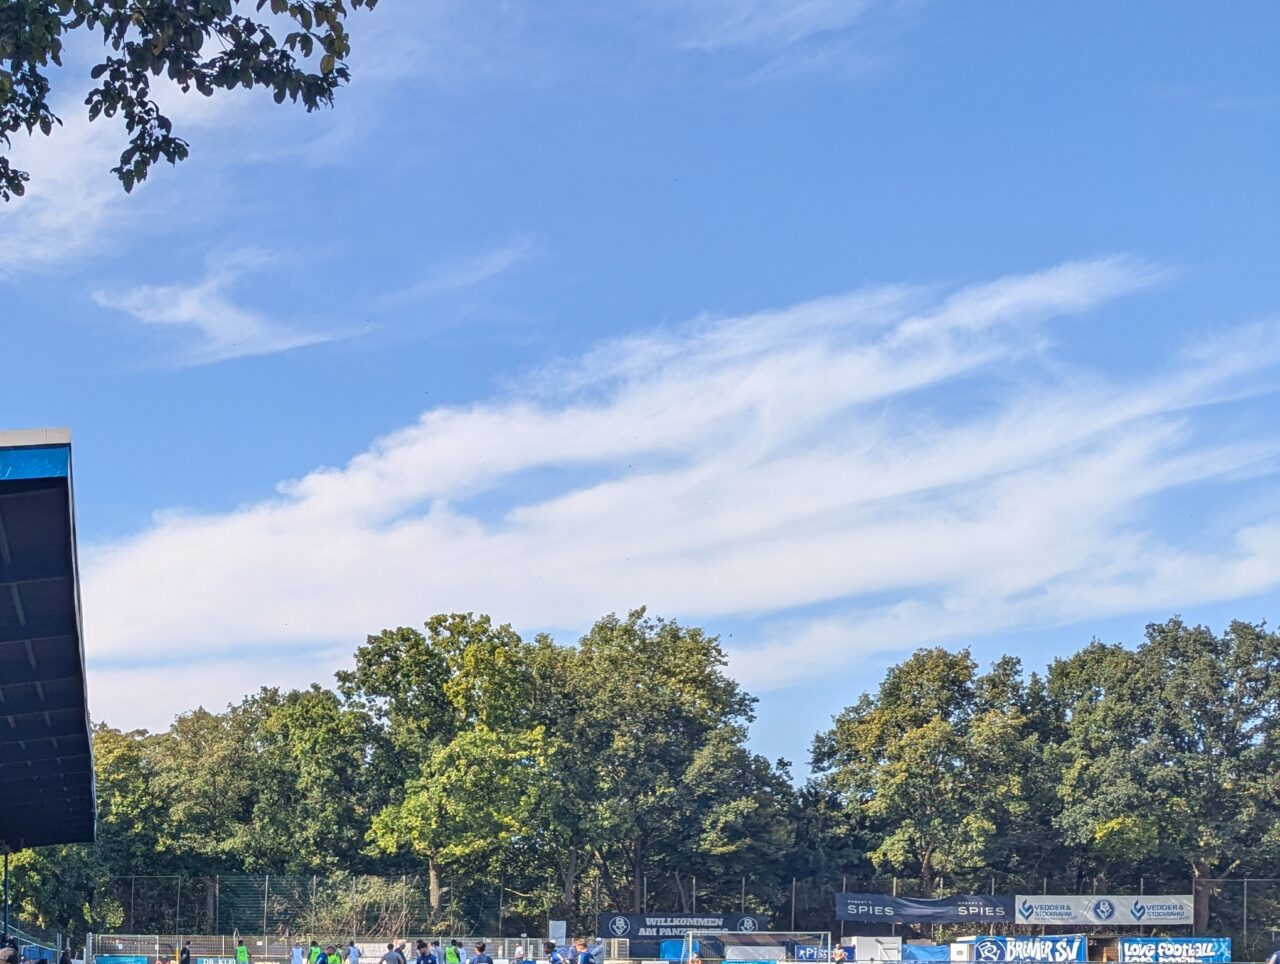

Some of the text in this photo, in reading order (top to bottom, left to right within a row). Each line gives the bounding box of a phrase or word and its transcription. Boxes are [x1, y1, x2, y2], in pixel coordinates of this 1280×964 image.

[847, 905, 895, 916] SPIES
[958, 906, 1005, 916] SPIES
[645, 917, 723, 926] WILLKOMMEN
[638, 927, 657, 936] AM
[1006, 937, 1082, 962] BREMER SV
